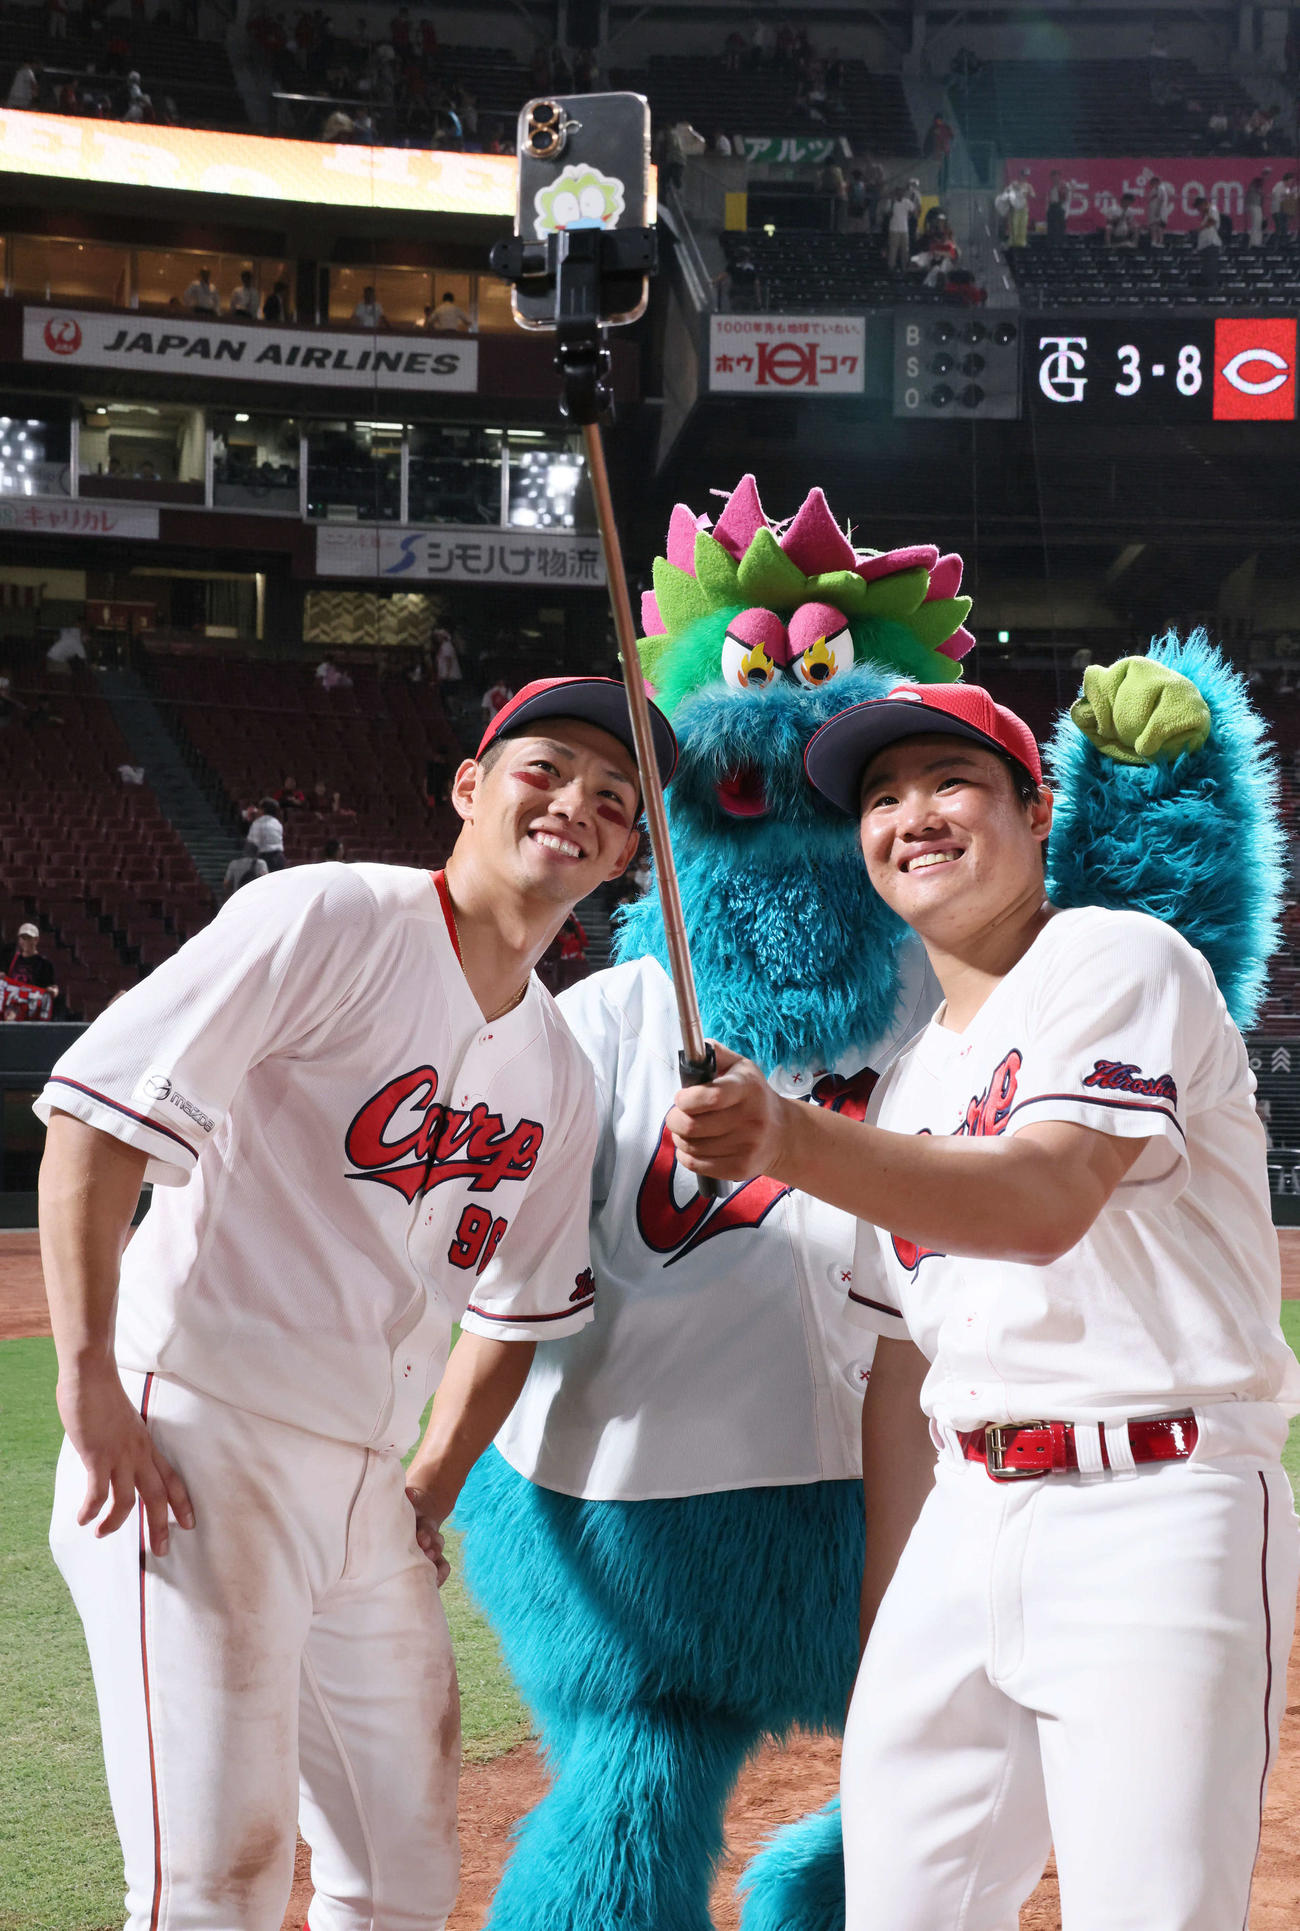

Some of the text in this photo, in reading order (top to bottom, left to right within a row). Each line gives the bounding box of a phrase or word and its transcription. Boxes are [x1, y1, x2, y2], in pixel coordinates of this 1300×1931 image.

[744, 137, 835, 163] アルツ
[905, 324, 921, 346] B
[103, 329, 461, 377] JAPAN AIRLINES
[905, 355, 920, 378] S
[904, 388, 920, 409] O
[24, 505, 119, 532] キャリカレ
[427, 542, 600, 580] シモハナ物流
[170, 1091, 215, 1133] mazda
[344, 1064, 544, 1206] Carp
